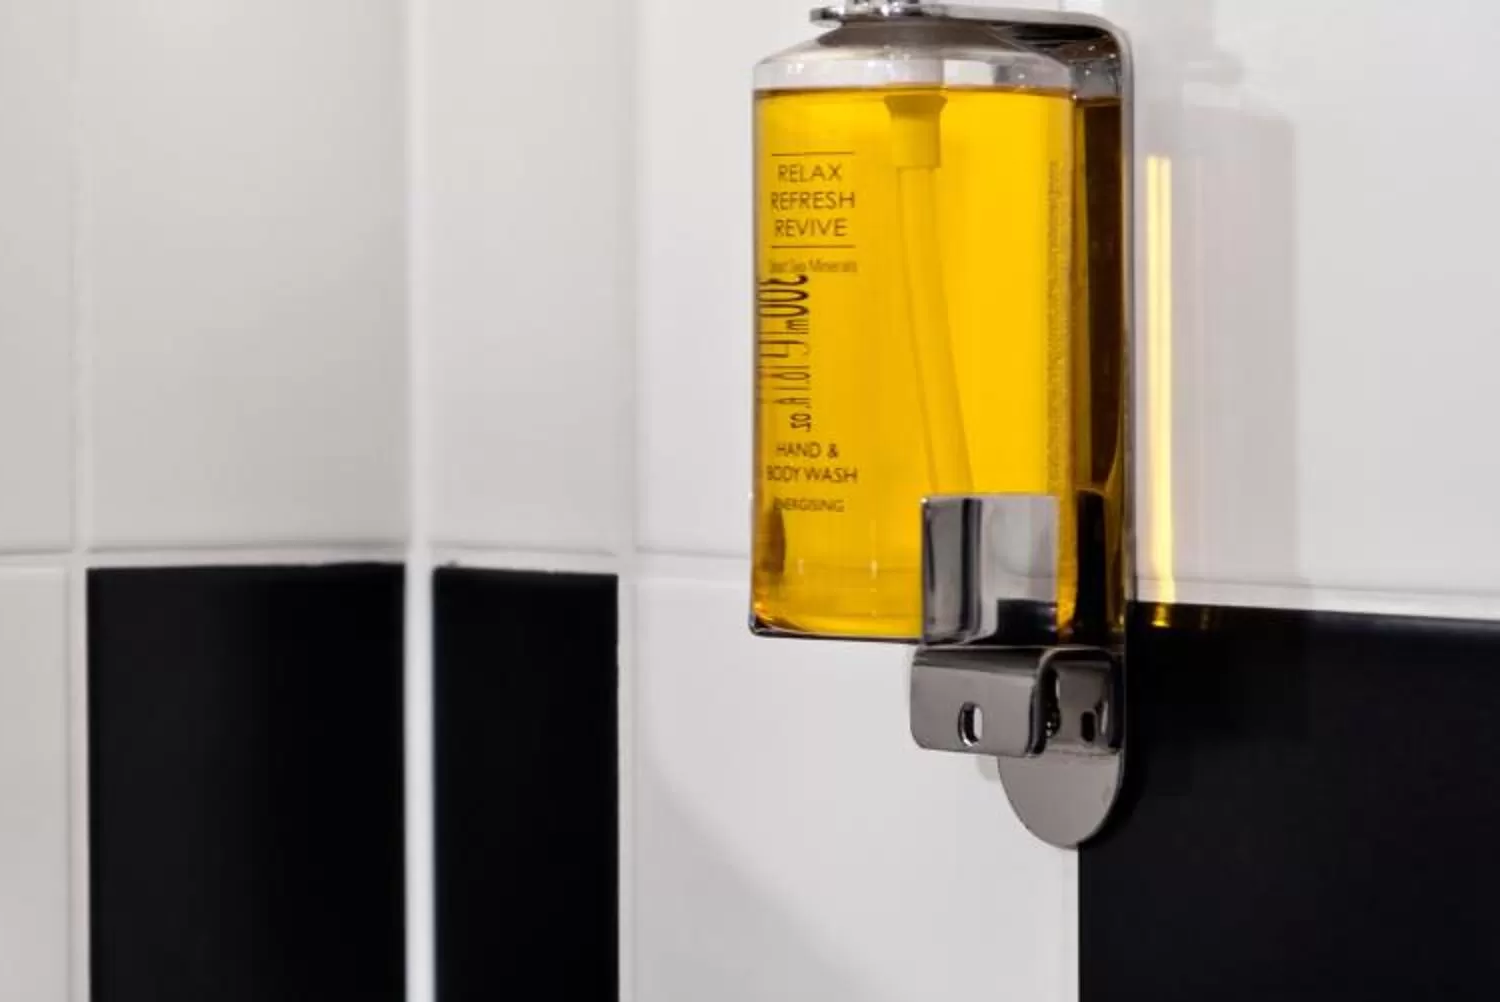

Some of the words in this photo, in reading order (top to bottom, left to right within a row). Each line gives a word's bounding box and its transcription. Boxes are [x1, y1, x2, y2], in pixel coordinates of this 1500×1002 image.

[777, 163, 842, 182] RELAX
[771, 191, 856, 212] REFRESH
[774, 218, 849, 238] REVIVE
[776, 442, 822, 458] HAND
[827, 443, 839, 458] &
[766, 465, 800, 482] BODY
[804, 467, 858, 484] WASH
